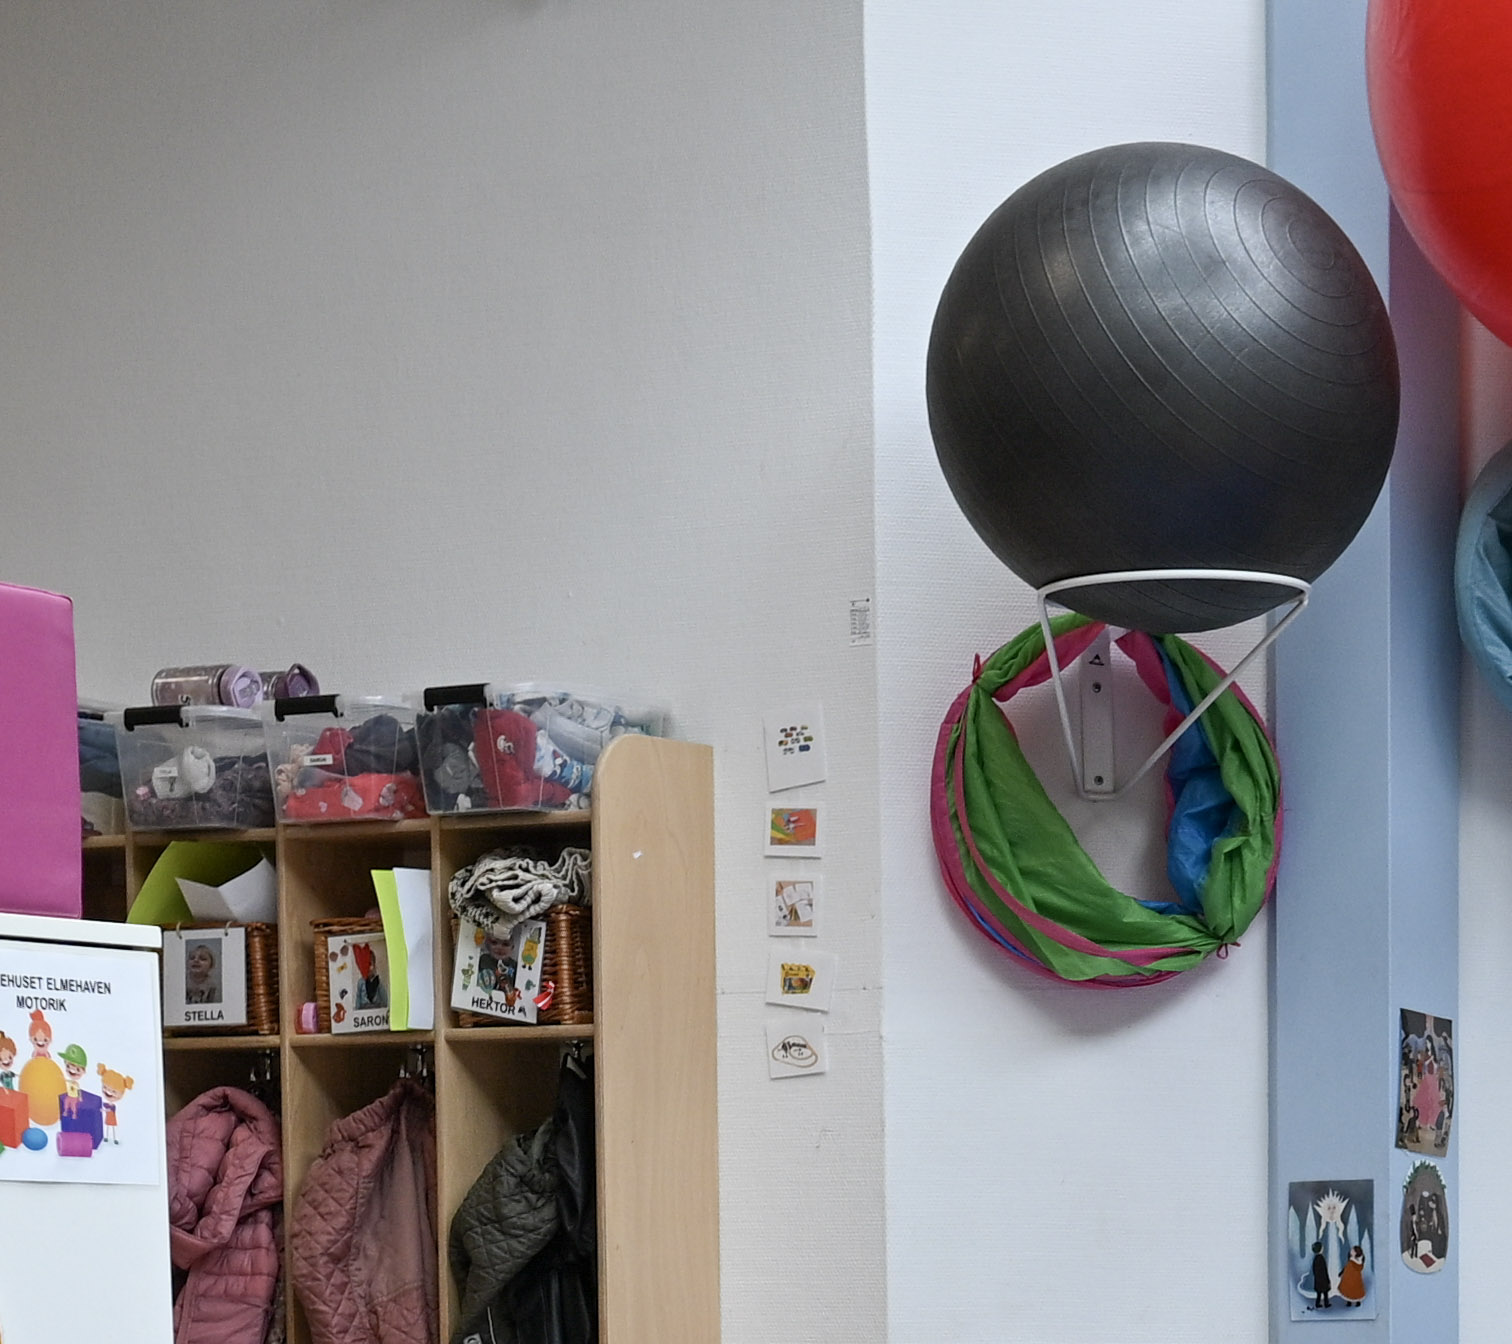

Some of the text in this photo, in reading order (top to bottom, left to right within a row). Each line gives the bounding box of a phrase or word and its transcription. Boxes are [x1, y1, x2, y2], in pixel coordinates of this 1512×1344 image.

[46, 977, 112, 995] ELMEHAVEN
[16, 995, 68, 1012] MOTORIK
[471, 996, 516, 1016] HEKTOR
[184, 1010, 225, 1022] STELLA
